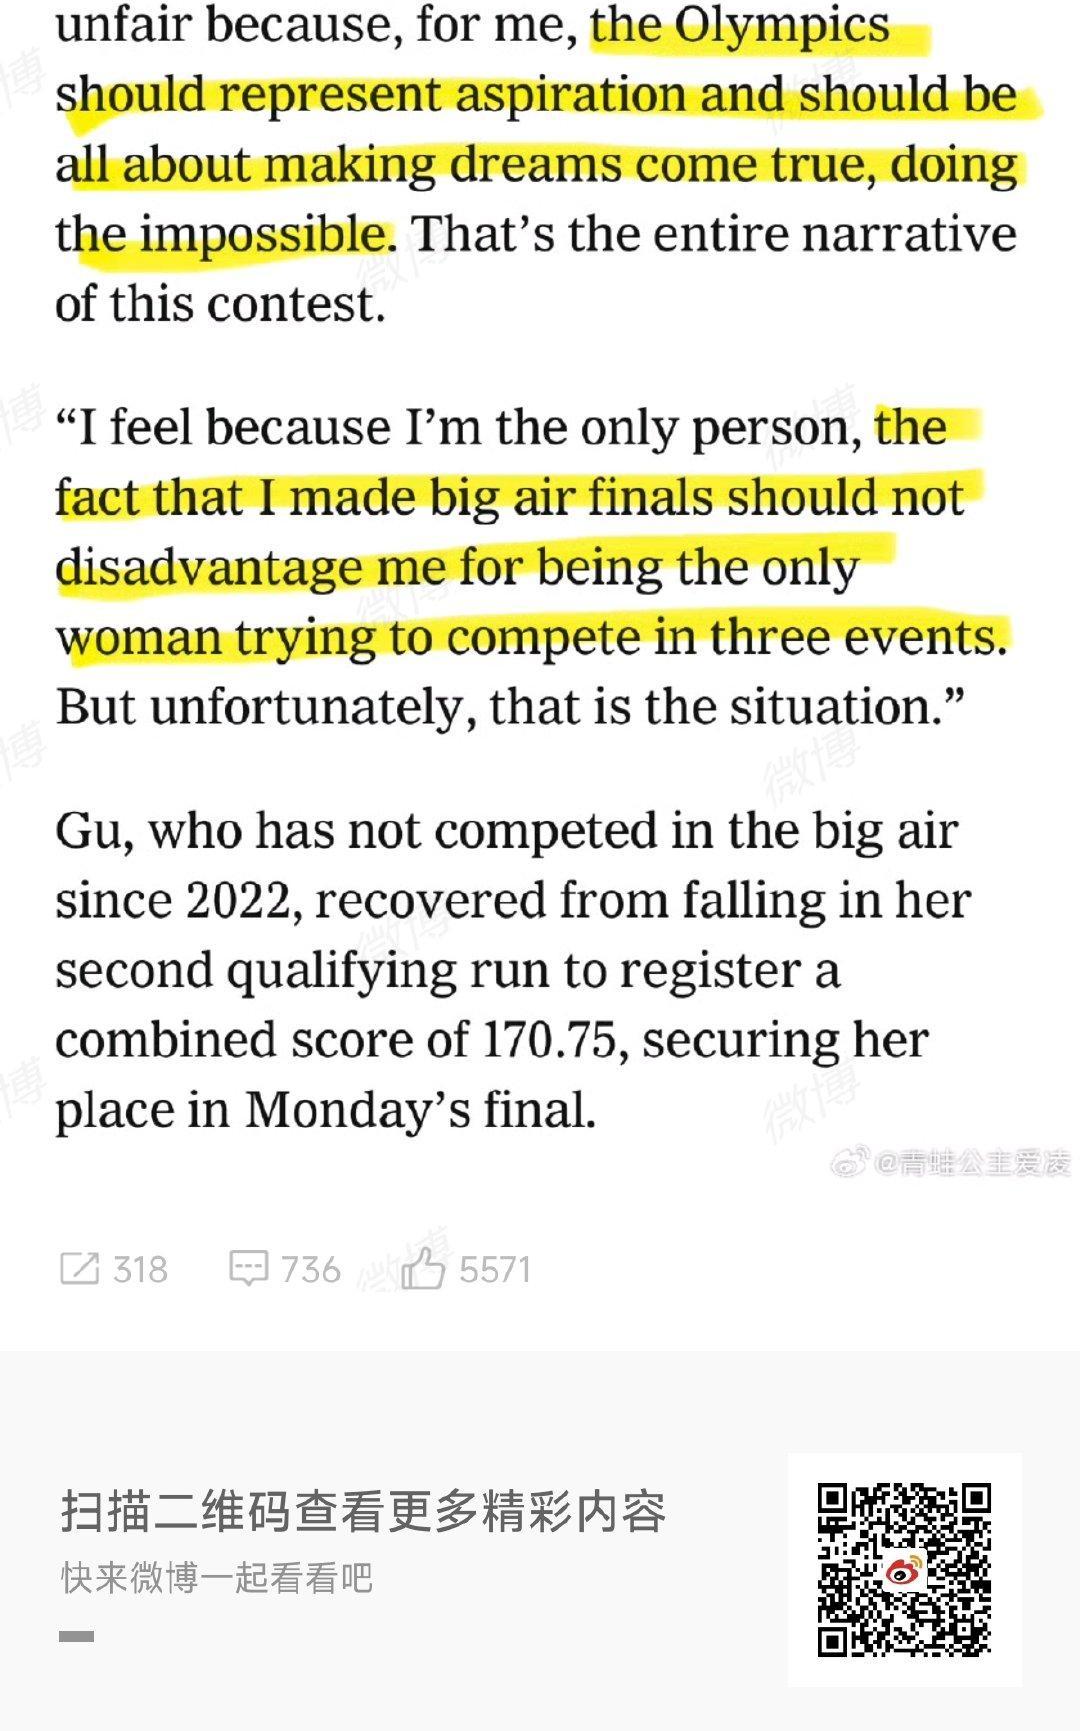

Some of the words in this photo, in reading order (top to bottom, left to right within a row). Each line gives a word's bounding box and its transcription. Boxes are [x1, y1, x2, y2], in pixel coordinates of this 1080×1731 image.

[55, 3, 193, 43] unfair
[205, 3, 403, 50] because,
[416, 3, 481, 43] for
[495, 13, 577, 51] me,
[589, 3, 662, 43] the
[675, 3, 890, 53] Olympics
[56, 73, 206, 112] should
[219, 77, 442, 123] represent
[456, 73, 686, 123] aspiration
[701, 73, 785, 112] and
[800, 73, 950, 112] should
[963, 73, 1017, 112] be
[55, 282, 99, 322] of
[109, 282, 194, 322] this
[207, 287, 385, 322] contest.
[110, 406, 193, 445] feel
[206, 406, 391, 445] because
[495, 406, 568, 445] the
[581, 406, 680, 455] only
[692, 416, 861, 456] person,
[873, 406, 947, 445] the
[55, 545, 363, 596] disadvantage
[377, 557, 446, 586] me
[459, 545, 524, 586] for
[536, 545, 664, 596] being
[676, 545, 749, 586] the
[762, 546, 861, 596] only
[54, 626, 223, 656] woman
[234, 615, 377, 666] trying
[389, 621, 433, 656] to
[447, 621, 641, 666] compete
[654, 615, 698, 655] in
[710, 616, 831, 656] three
[845, 620, 1006, 656] events.
[56, 687, 137, 726] But
[150, 685, 476, 735] unfortunately,
[489, 686, 581, 726] that
[594, 685, 631, 725] is
[644, 685, 717, 726] the
[56, 879, 172, 920] since
[187, 880, 302, 927] 2022,
[315, 879, 547, 920] recovered
[560, 879, 669, 919] from
[683, 879, 826, 929] falling
[839, 879, 883, 919] in
[895, 879, 973, 920] her
[56, 949, 214, 989] second
[227, 949, 457, 999] qualifying
[471, 959, 550, 989] run
[564, 954, 607, 989] to
[620, 949, 802, 999] register
[815, 959, 842, 989] a
[55, 1019, 277, 1059] combined
[292, 1028, 414, 1059] score
[427, 1019, 471, 1059] of
[485, 1019, 629, 1066] 170.75,
[643, 1019, 840, 1069] securing
[853, 1019, 930, 1058] her
[55, 1089, 175, 1138] place
[188, 1089, 231, 1128] in
[484, 1089, 595, 1128] final.
[113, 1255, 168, 1283] 318
[281, 1255, 341, 1283] 736
[460, 1255, 531, 1283] 5571
[60, 1487, 666, 1533] 扫描二维码查看更多精彩内容
[60, 1560, 373, 1595] 快来微博一起看看吧
